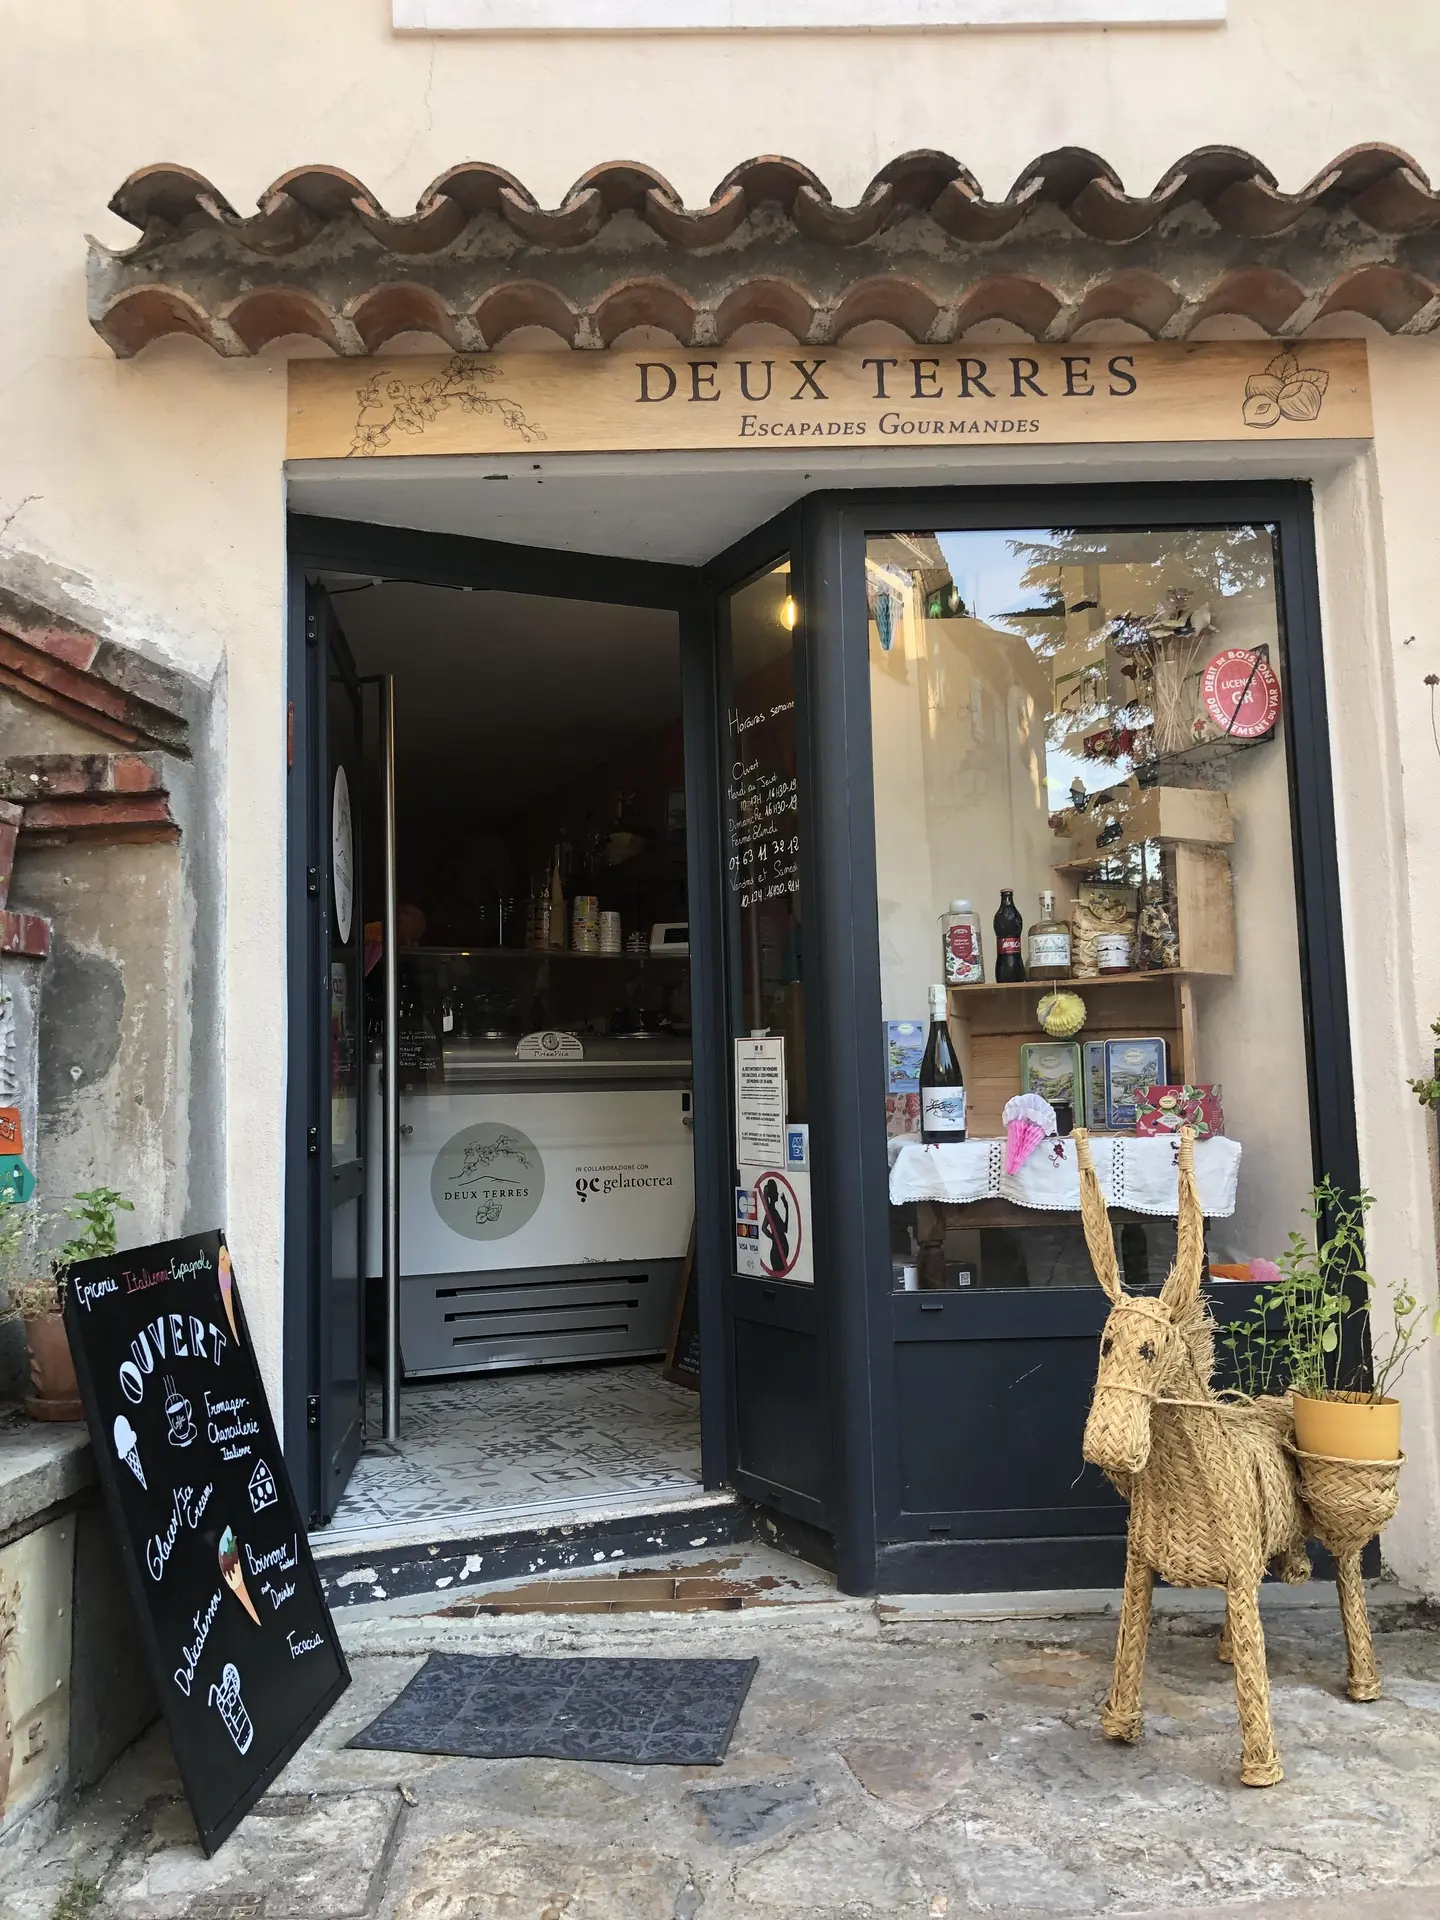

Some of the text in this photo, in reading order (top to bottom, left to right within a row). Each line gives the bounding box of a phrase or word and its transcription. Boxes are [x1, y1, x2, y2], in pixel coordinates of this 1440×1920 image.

[635, 355, 1138, 403] DEUX TERRES
[1204, 666, 1218, 692] DEBIT
[1216, 656, 1226, 666] DE
[1269, 689, 1279, 707] VAR
[1268, 710, 1277, 720] DU
[742, 849, 754, 865] 63
[772, 839, 784, 854] 32
[583, 1164, 635, 1172] COLLABORAZIONE
[444, 1187, 530, 1200] DEUX TERRES
[603, 1173, 673, 1194] gelatocrea
[119, 1313, 227, 1404] OUVERT
